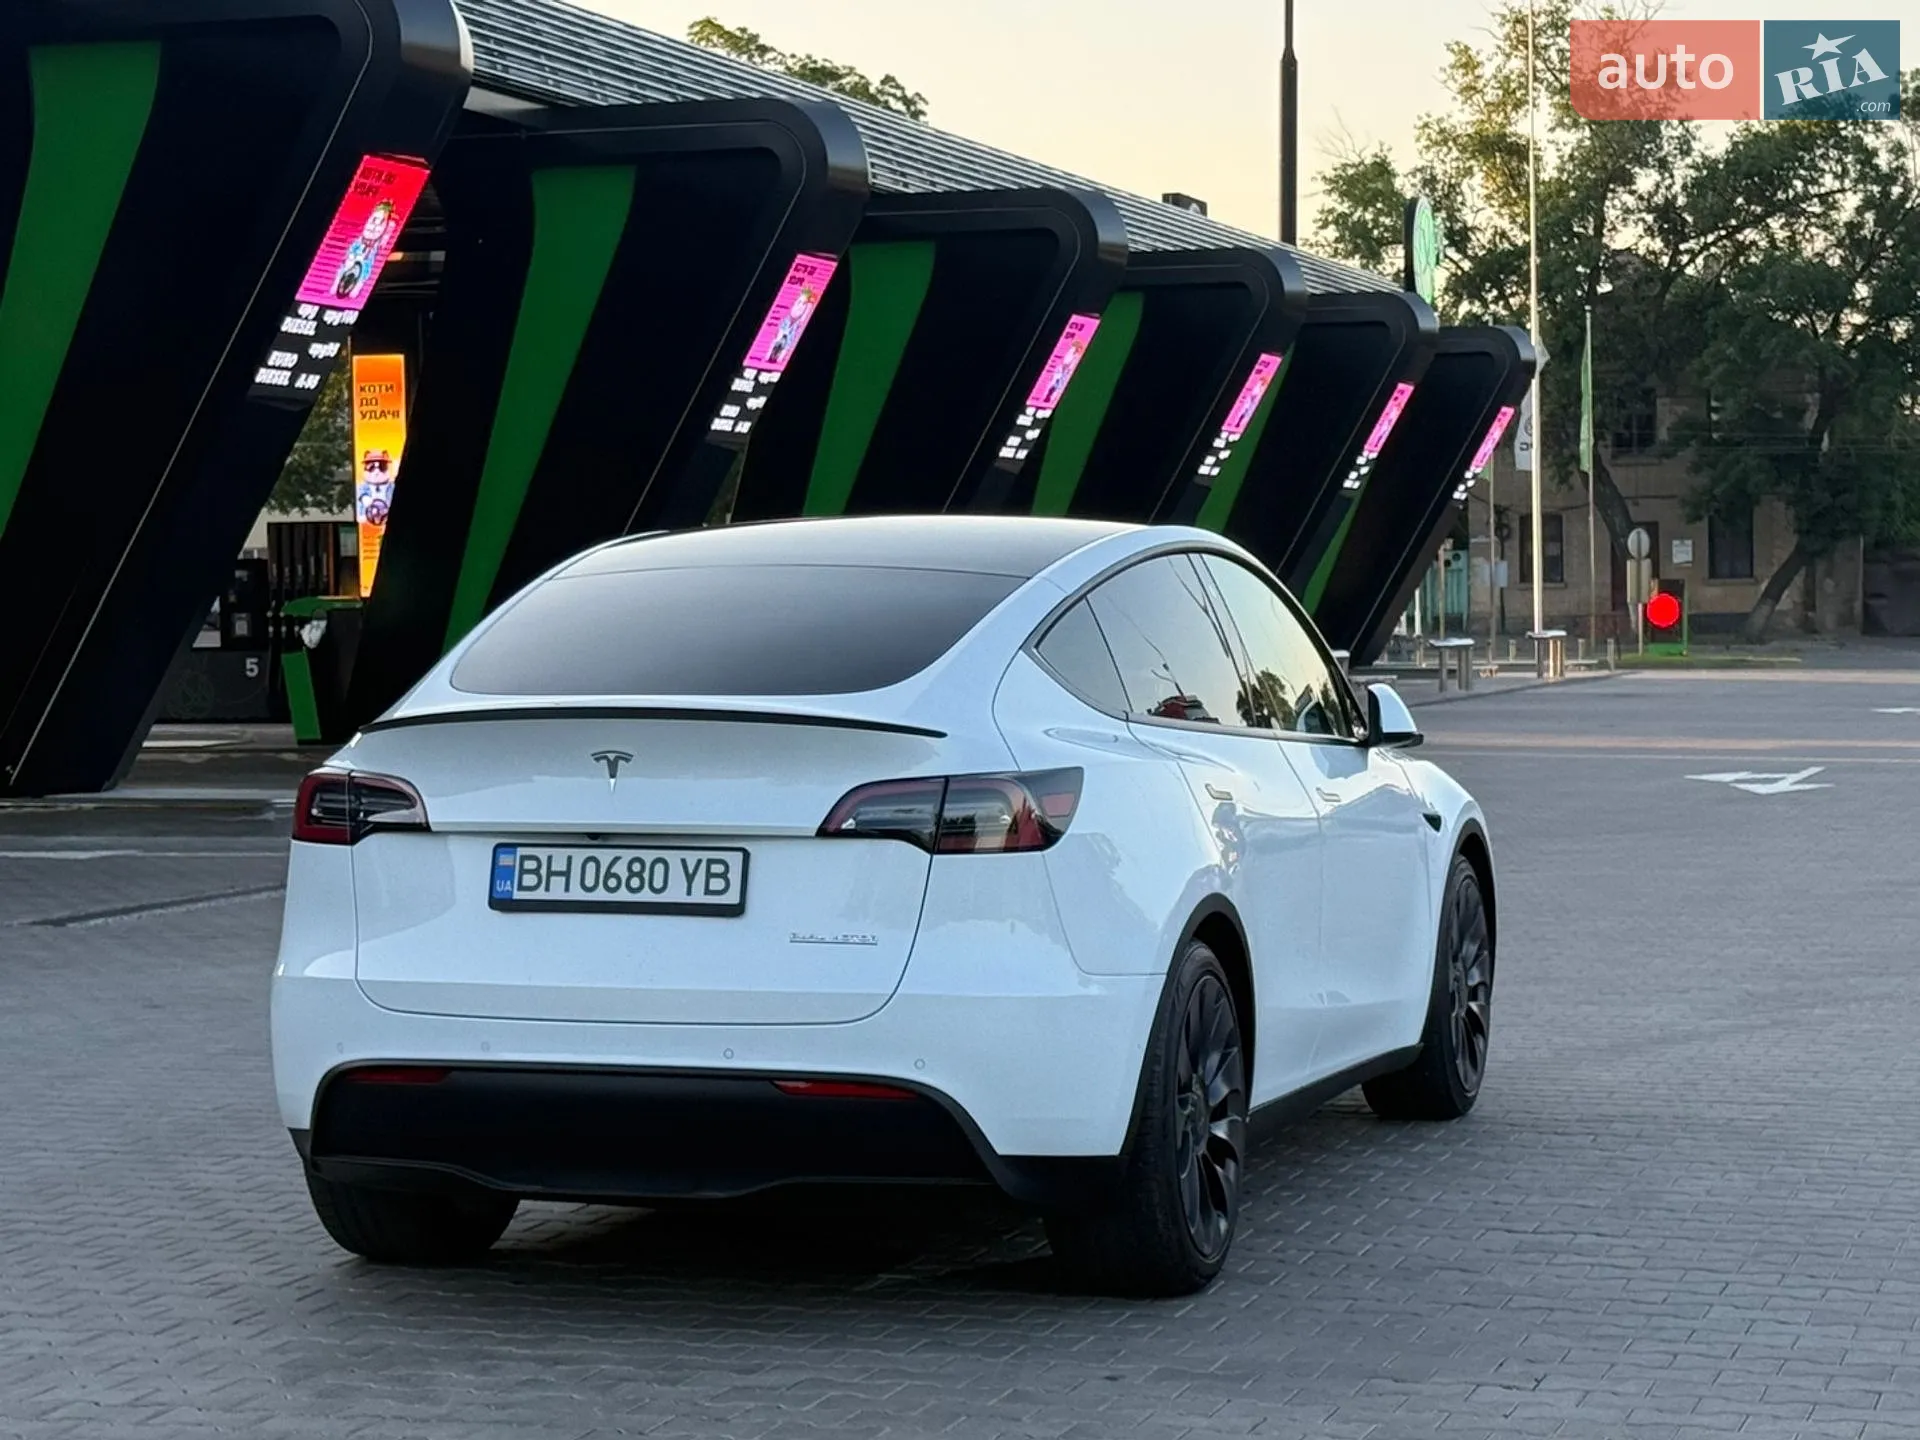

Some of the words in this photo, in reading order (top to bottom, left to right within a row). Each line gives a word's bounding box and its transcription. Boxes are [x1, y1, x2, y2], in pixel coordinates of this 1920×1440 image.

[359, 383, 395, 393] КОТИ
[245, 657, 259, 677] 5
[517, 854, 573, 893] BH
[579, 855, 670, 895] 0680
[680, 857, 731, 896] YB
[496, 879, 512, 893] UA
